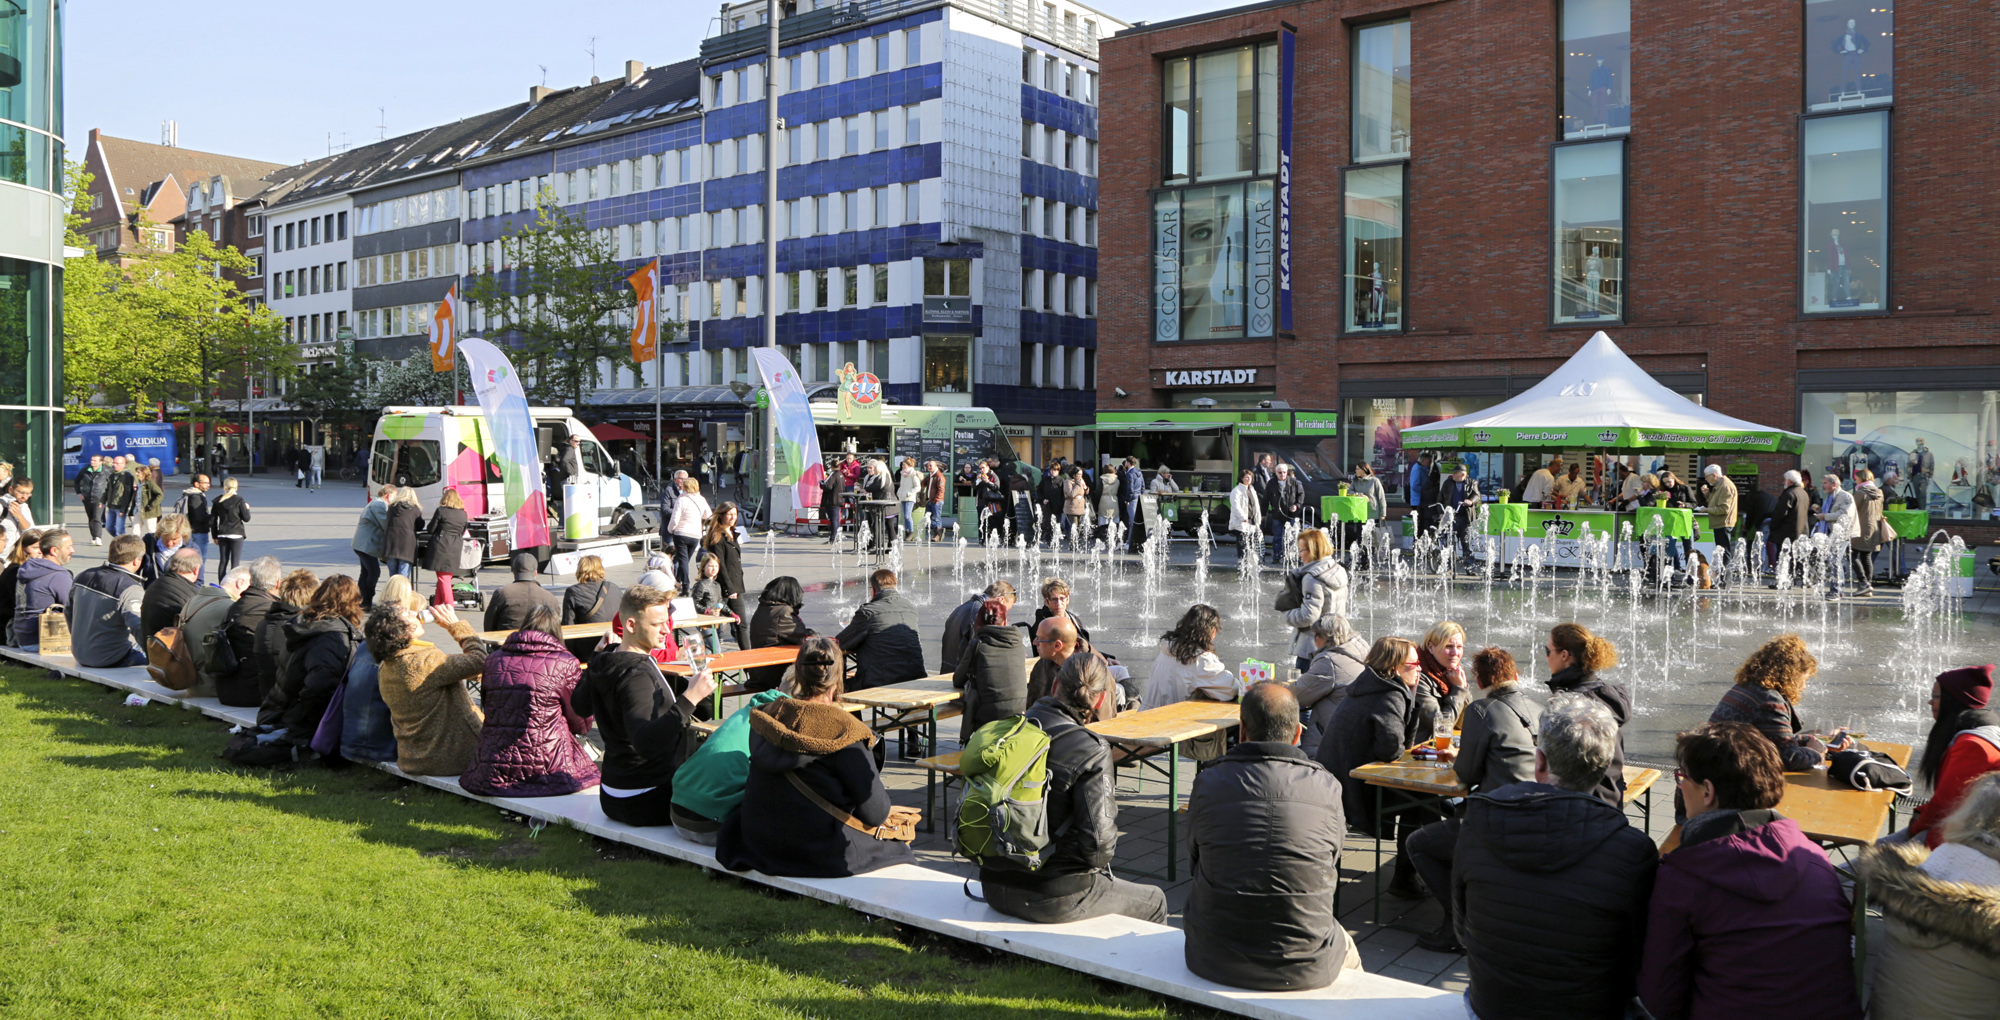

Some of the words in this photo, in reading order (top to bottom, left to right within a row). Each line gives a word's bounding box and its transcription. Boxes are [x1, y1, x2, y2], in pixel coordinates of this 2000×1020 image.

[1280, 149, 1290, 291] KARSTADT
[1254, 199, 1271, 310] COLLISTAR
[1161, 210, 1177, 315] COLLISTAR
[1165, 369, 1257, 386] KARSTADT
[849, 381, 881, 394] CIA
[634, 421, 650, 431] bolten
[1296, 419, 1304, 429] The
[1304, 419, 1325, 429] Freshfood
[1325, 419, 1336, 429] Truck
[954, 430, 974, 439] Poutine
[1047, 428, 1068, 436] Fielmann
[1516, 431, 1541, 440] Pierre
[1541, 431, 1568, 441] Dupré
[125, 437, 168, 446] GAUDIUM
[1638, 431, 1689, 443] Spezialitäten
[1690, 435, 1706, 443] von
[1707, 434, 1725, 444] Grill
[1725, 435, 1741, 444] und
[1742, 435, 1773, 446] Pfanne
